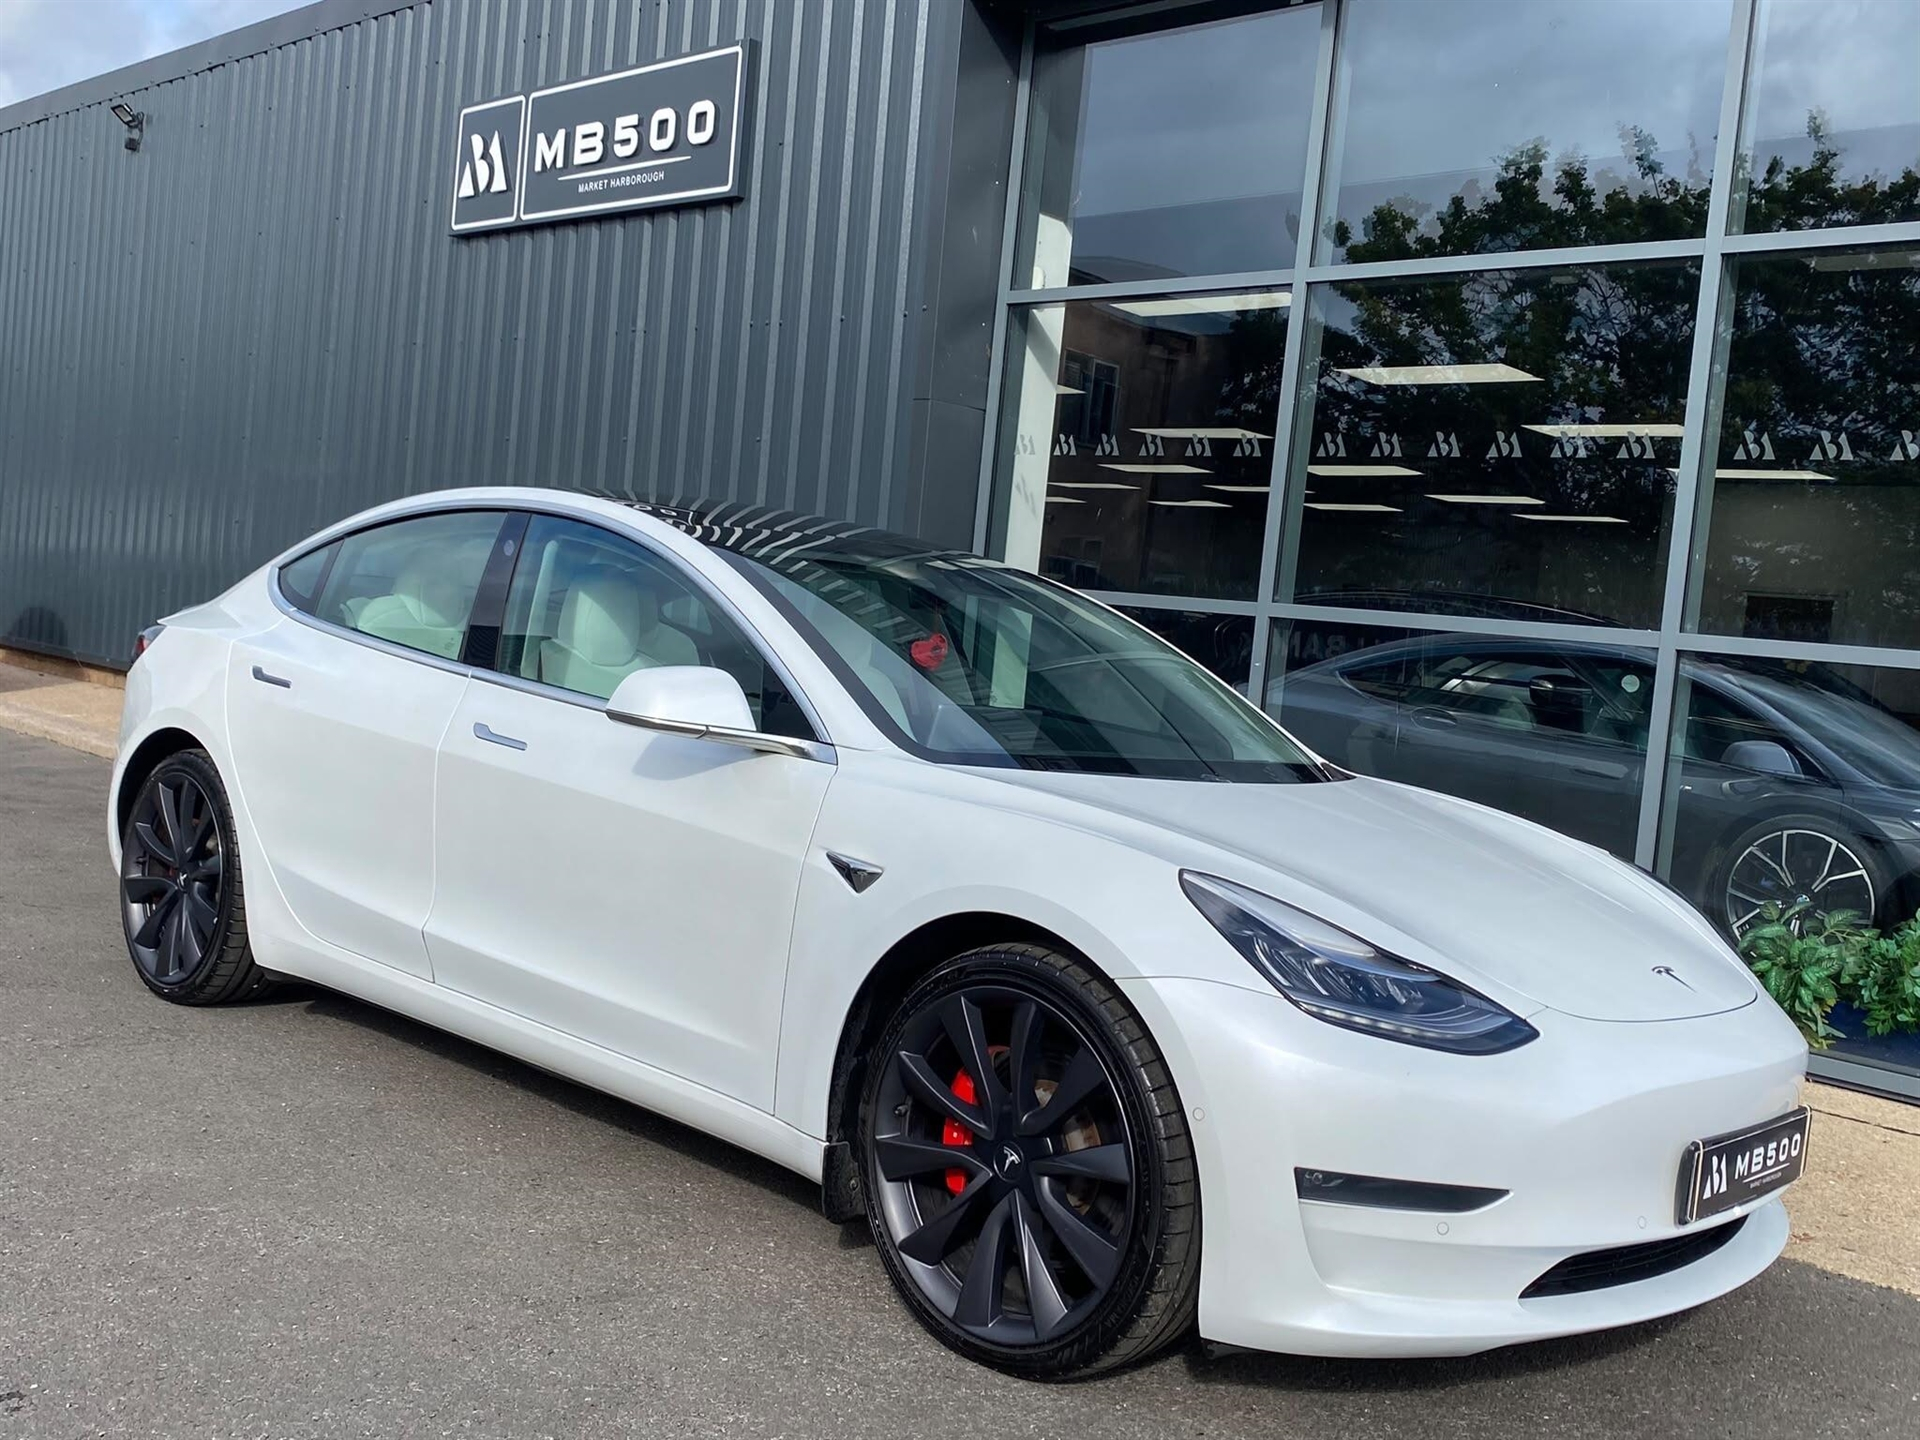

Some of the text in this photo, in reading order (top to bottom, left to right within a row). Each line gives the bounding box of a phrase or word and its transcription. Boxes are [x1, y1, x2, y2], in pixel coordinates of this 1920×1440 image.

[535, 99, 715, 172] MB500
[578, 170, 665, 192] MARKET HARBOROUGH
[1735, 1133, 1801, 1180] MB500
